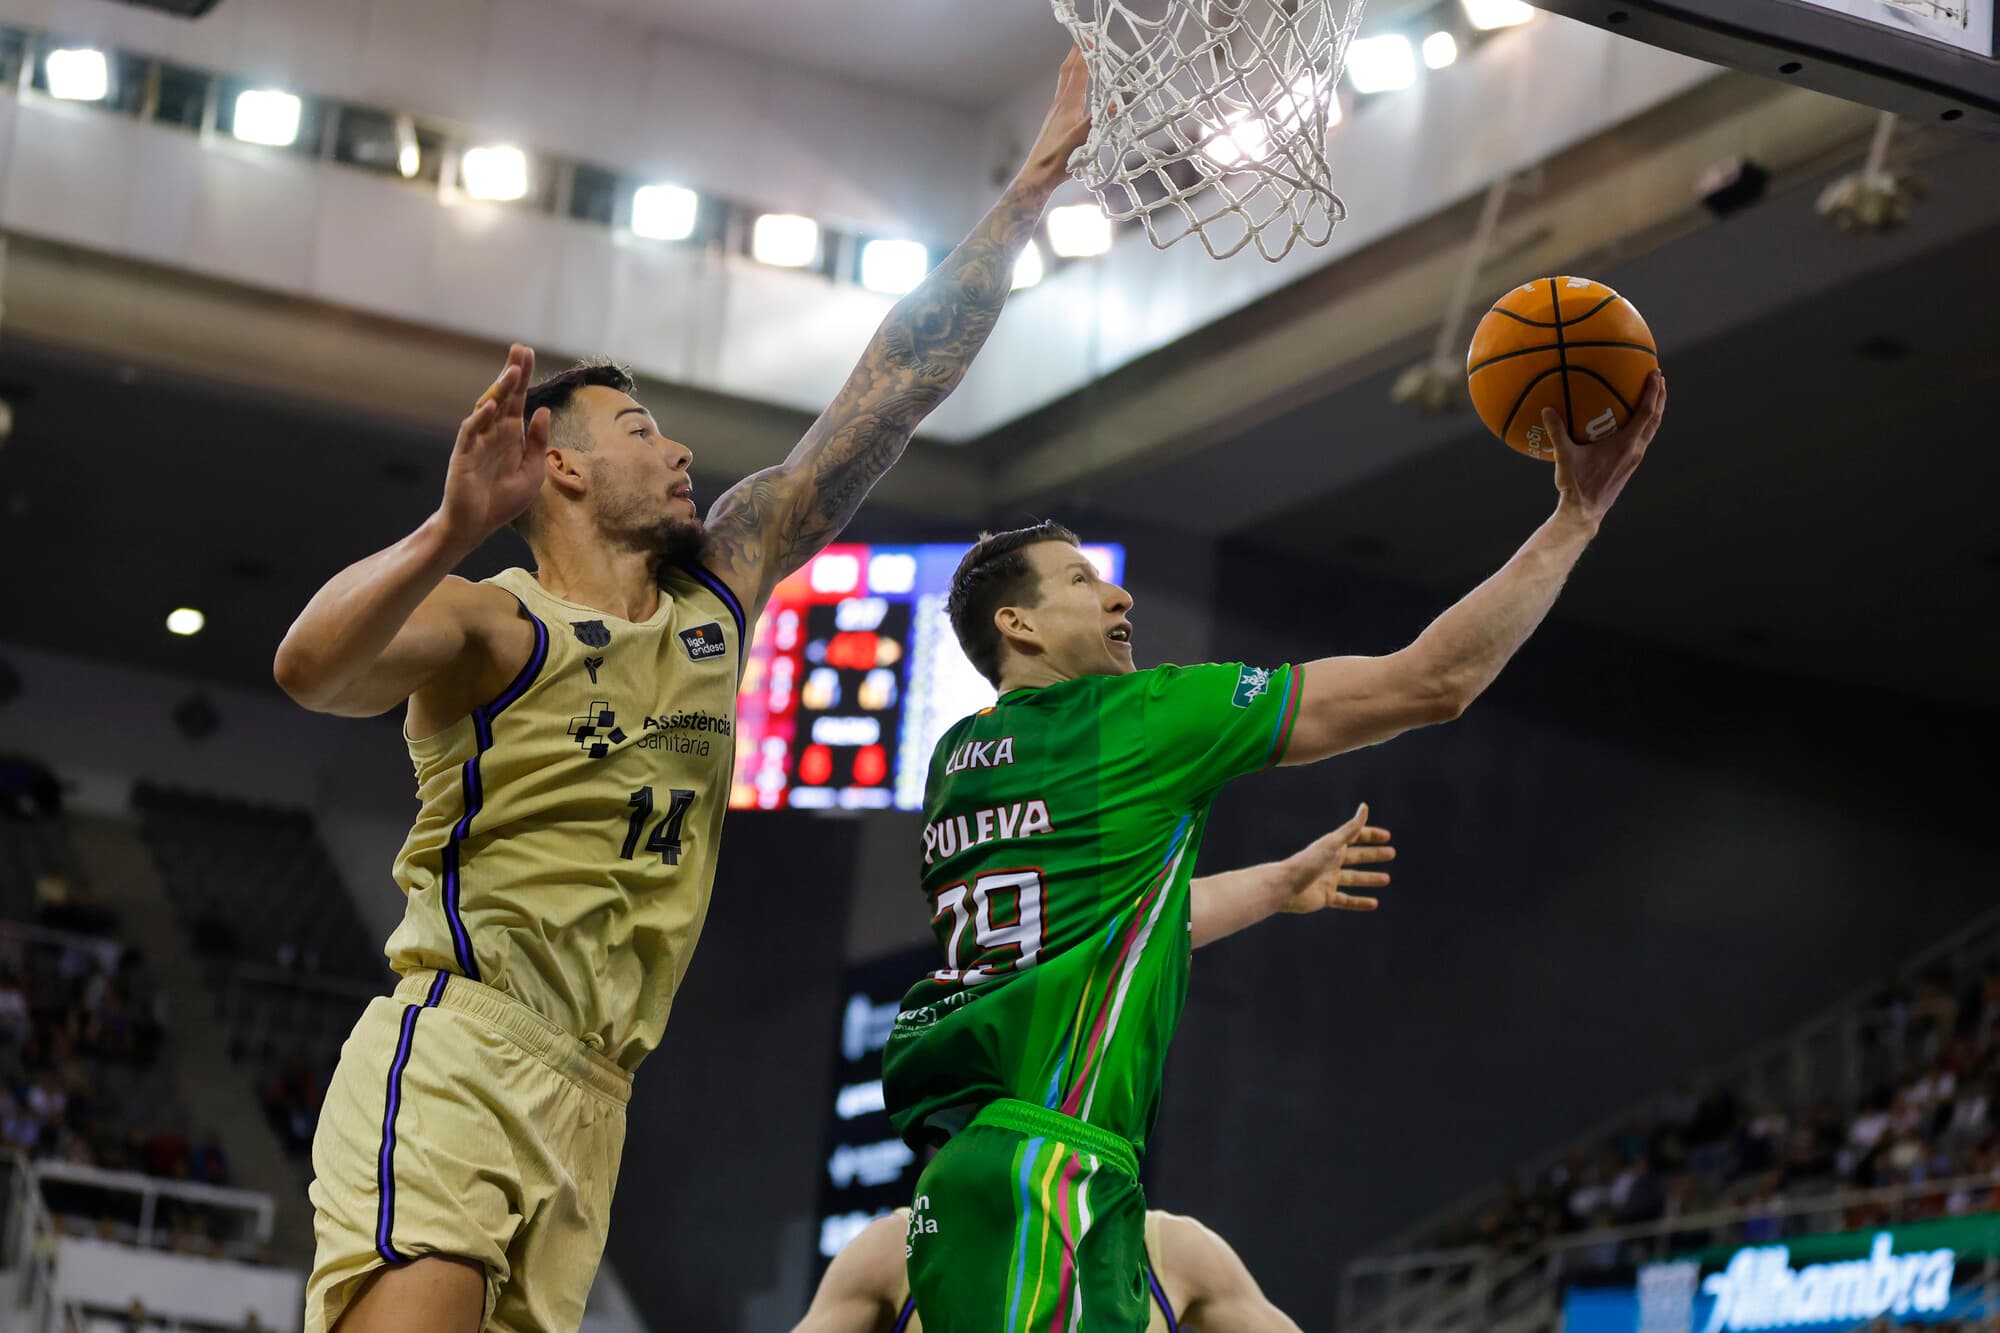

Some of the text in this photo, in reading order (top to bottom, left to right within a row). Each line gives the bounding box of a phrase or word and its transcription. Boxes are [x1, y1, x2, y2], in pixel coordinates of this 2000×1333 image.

[687, 636, 706, 648] liga
[691, 641, 725, 656] endesa
[643, 709, 731, 737] Assistència
[636, 730, 710, 757] Sanitària
[945, 736, 1017, 776] LUKA
[619, 786, 696, 865] 14
[923, 799, 1056, 865] PULEVA
[1703, 1231, 1955, 1331] Alhambra
